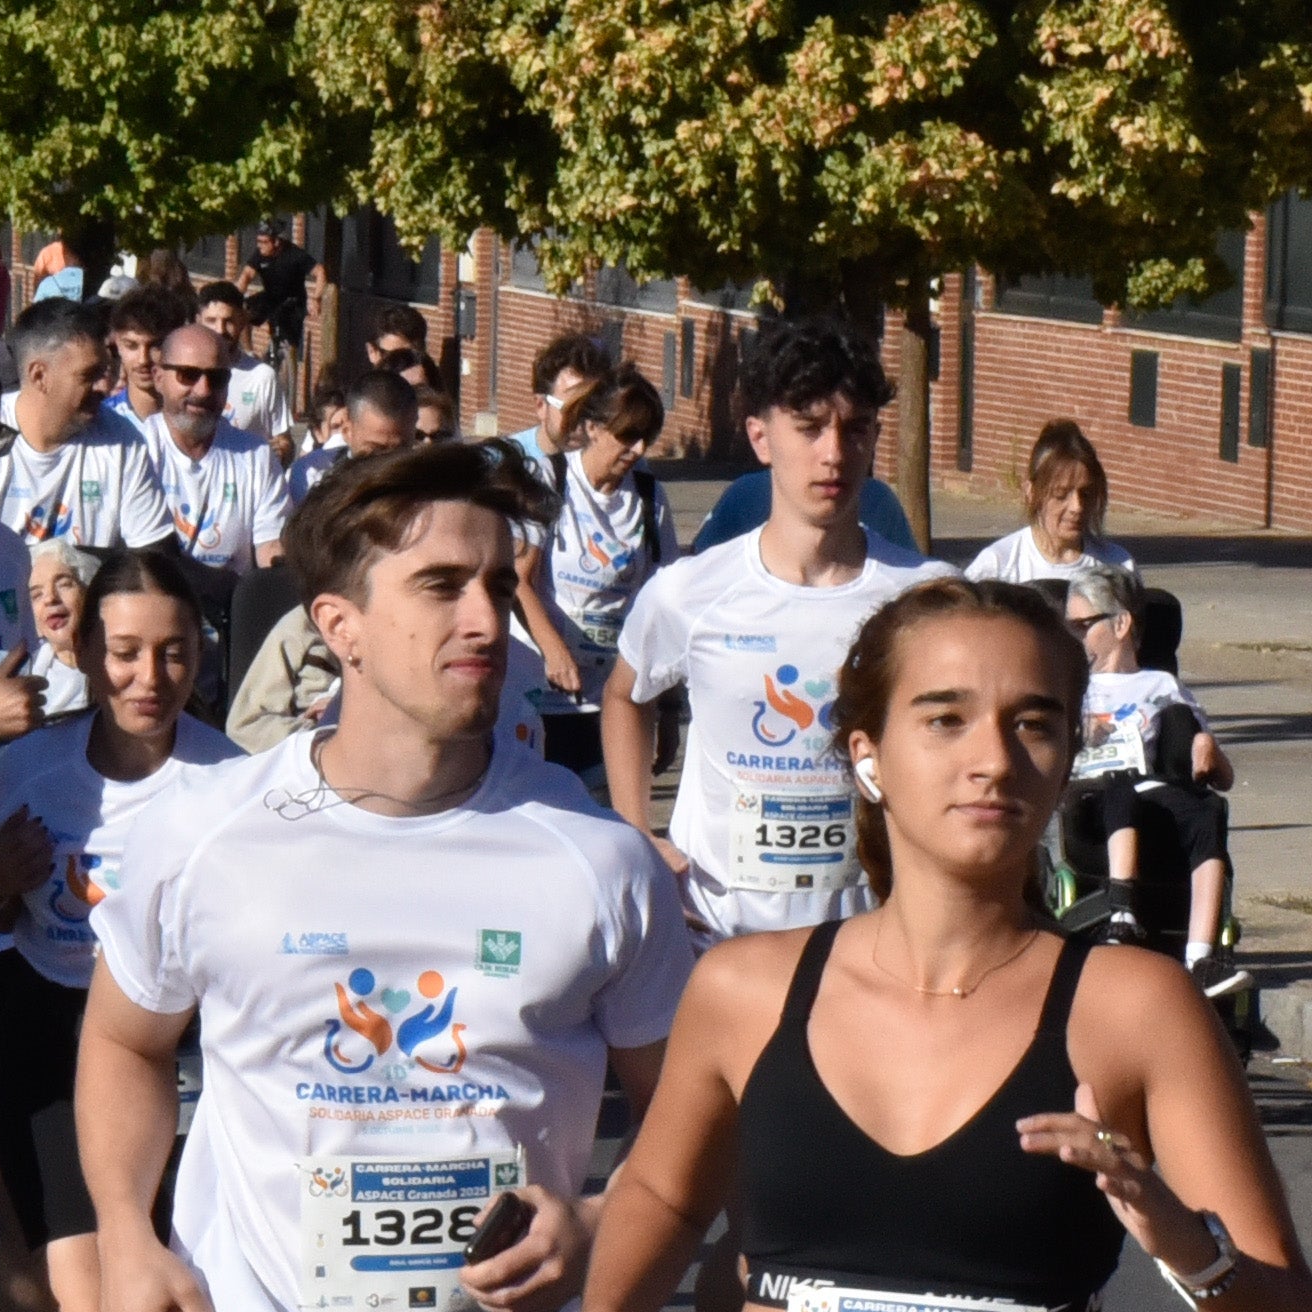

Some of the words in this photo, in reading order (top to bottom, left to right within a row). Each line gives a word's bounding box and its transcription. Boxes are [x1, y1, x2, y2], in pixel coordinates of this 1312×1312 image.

[755, 823, 847, 849] 1326
[295, 1081, 511, 1105] CARRERA-MARCHA
[308, 1106, 375, 1122] SOLIDARIA
[377, 1107, 430, 1121] ASPACE
[355, 1160, 486, 1174] CARRERA-MARCHA
[381, 1175, 456, 1187] SOLIDARIA
[355, 1189, 406, 1202] ASPACE
[406, 1188, 458, 1201] Granada
[459, 1186, 487, 1199] 2025
[342, 1205, 484, 1246] 1328
